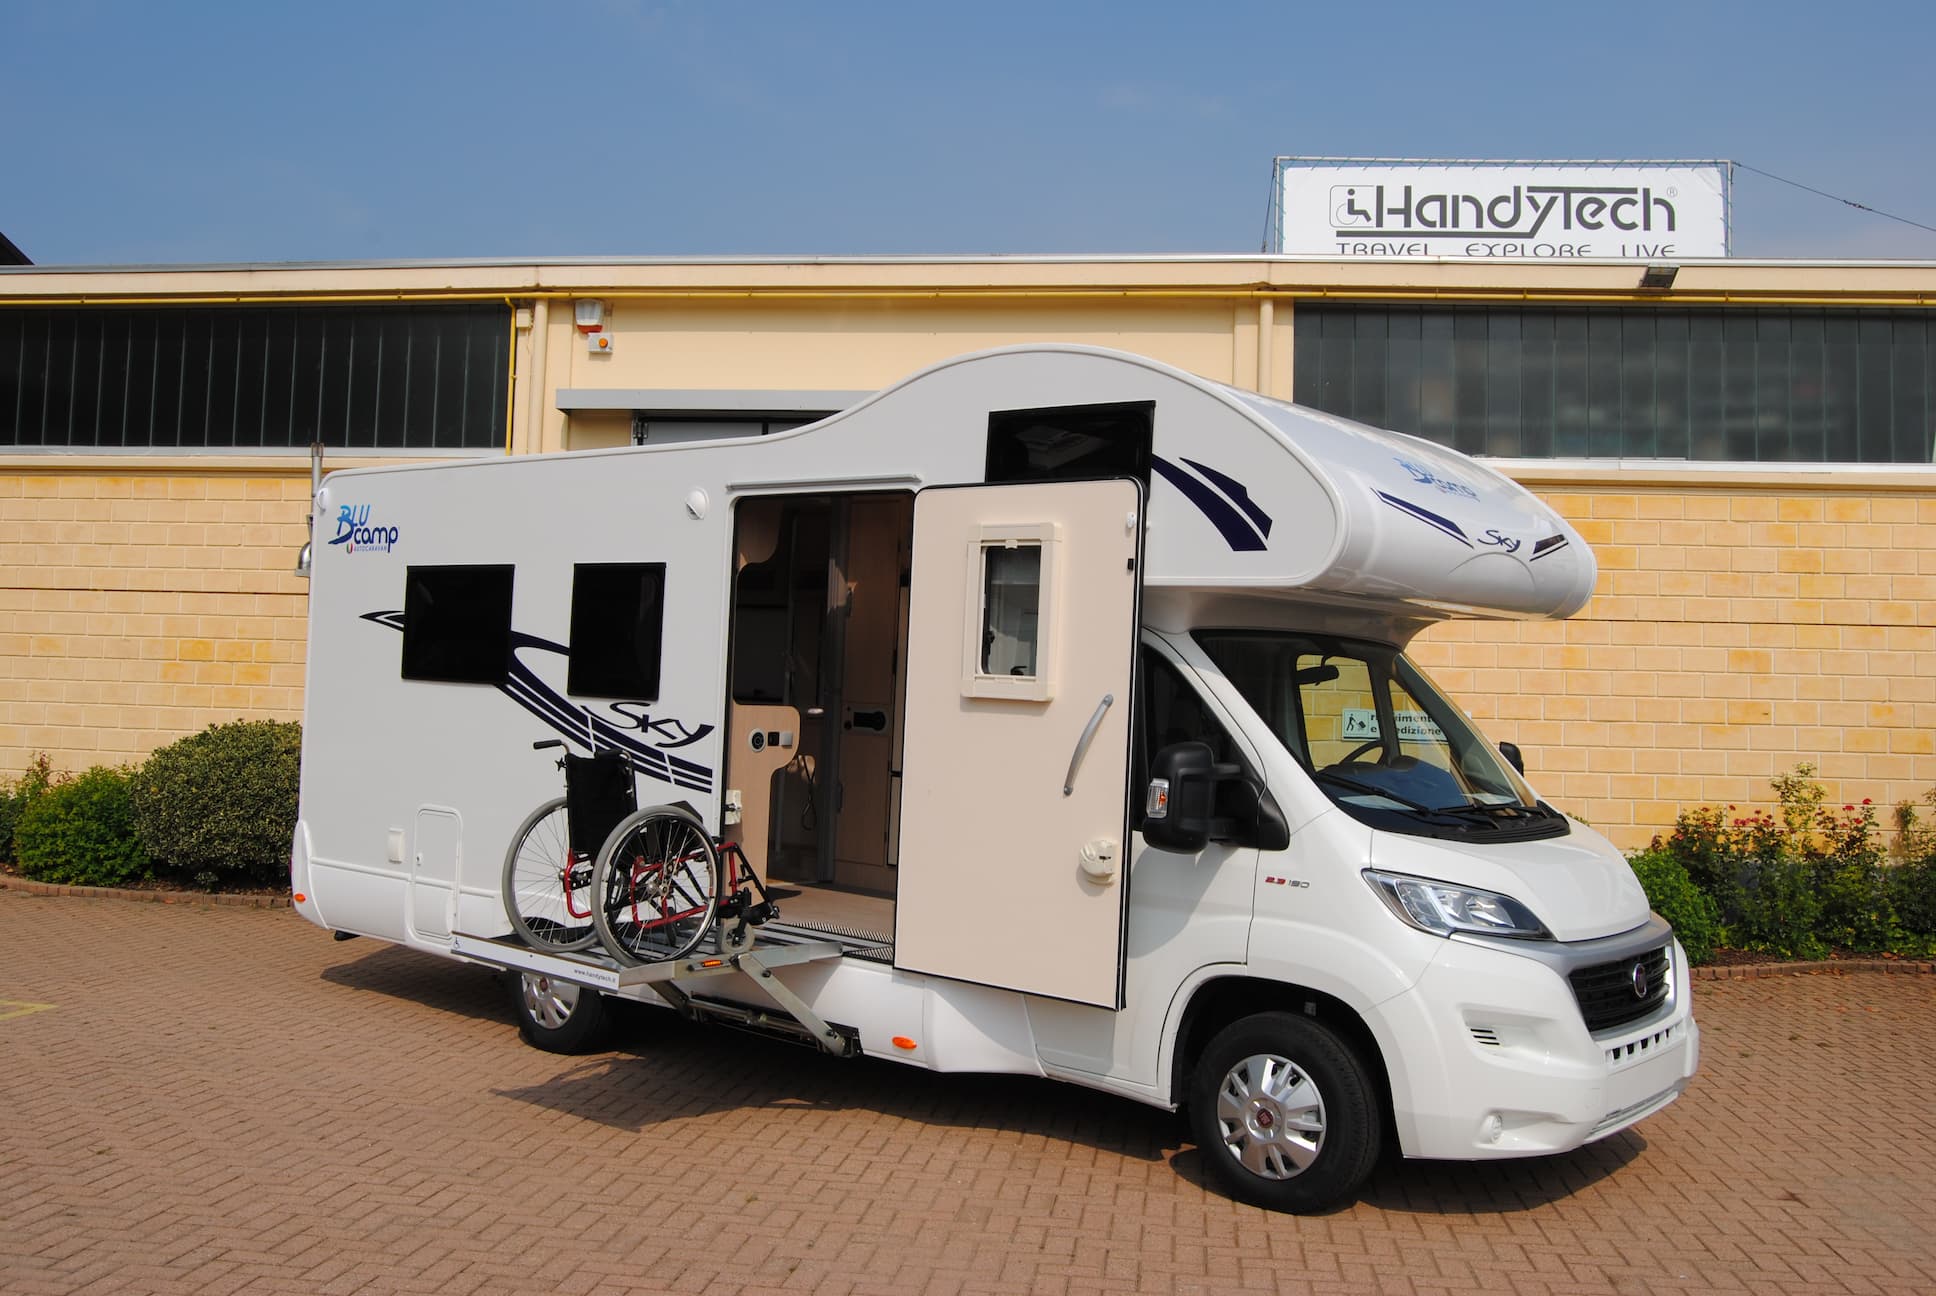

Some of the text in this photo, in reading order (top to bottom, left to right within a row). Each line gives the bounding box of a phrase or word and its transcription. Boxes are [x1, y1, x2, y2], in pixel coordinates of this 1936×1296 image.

[1336, 243, 1675, 257] TRAVEL EXPLORE LIVE
[354, 526, 399, 554] camp
